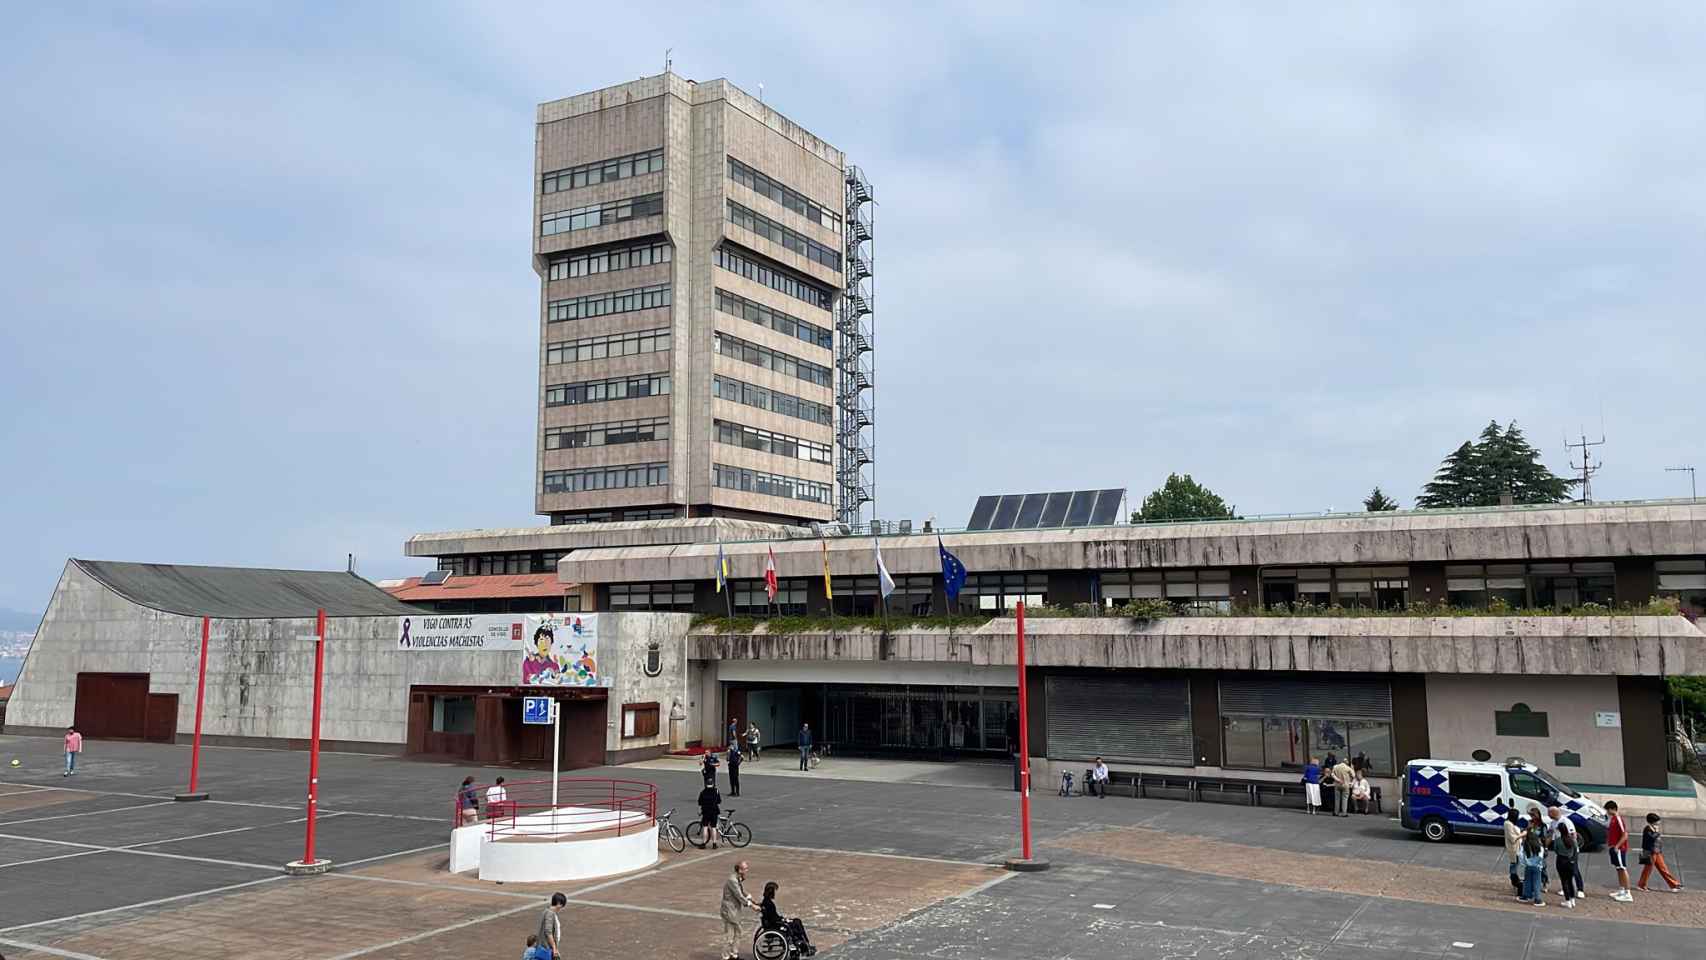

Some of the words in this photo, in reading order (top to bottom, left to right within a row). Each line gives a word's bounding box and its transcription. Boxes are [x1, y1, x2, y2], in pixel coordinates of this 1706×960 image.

[423, 617, 438, 630] VIGO
[438, 617, 462, 630] CONTRA
[463, 617, 473, 629] AS
[412, 635, 449, 648] VIOLENCIAS
[449, 635, 485, 648] MACHISTAS
[526, 699, 536, 713] P
